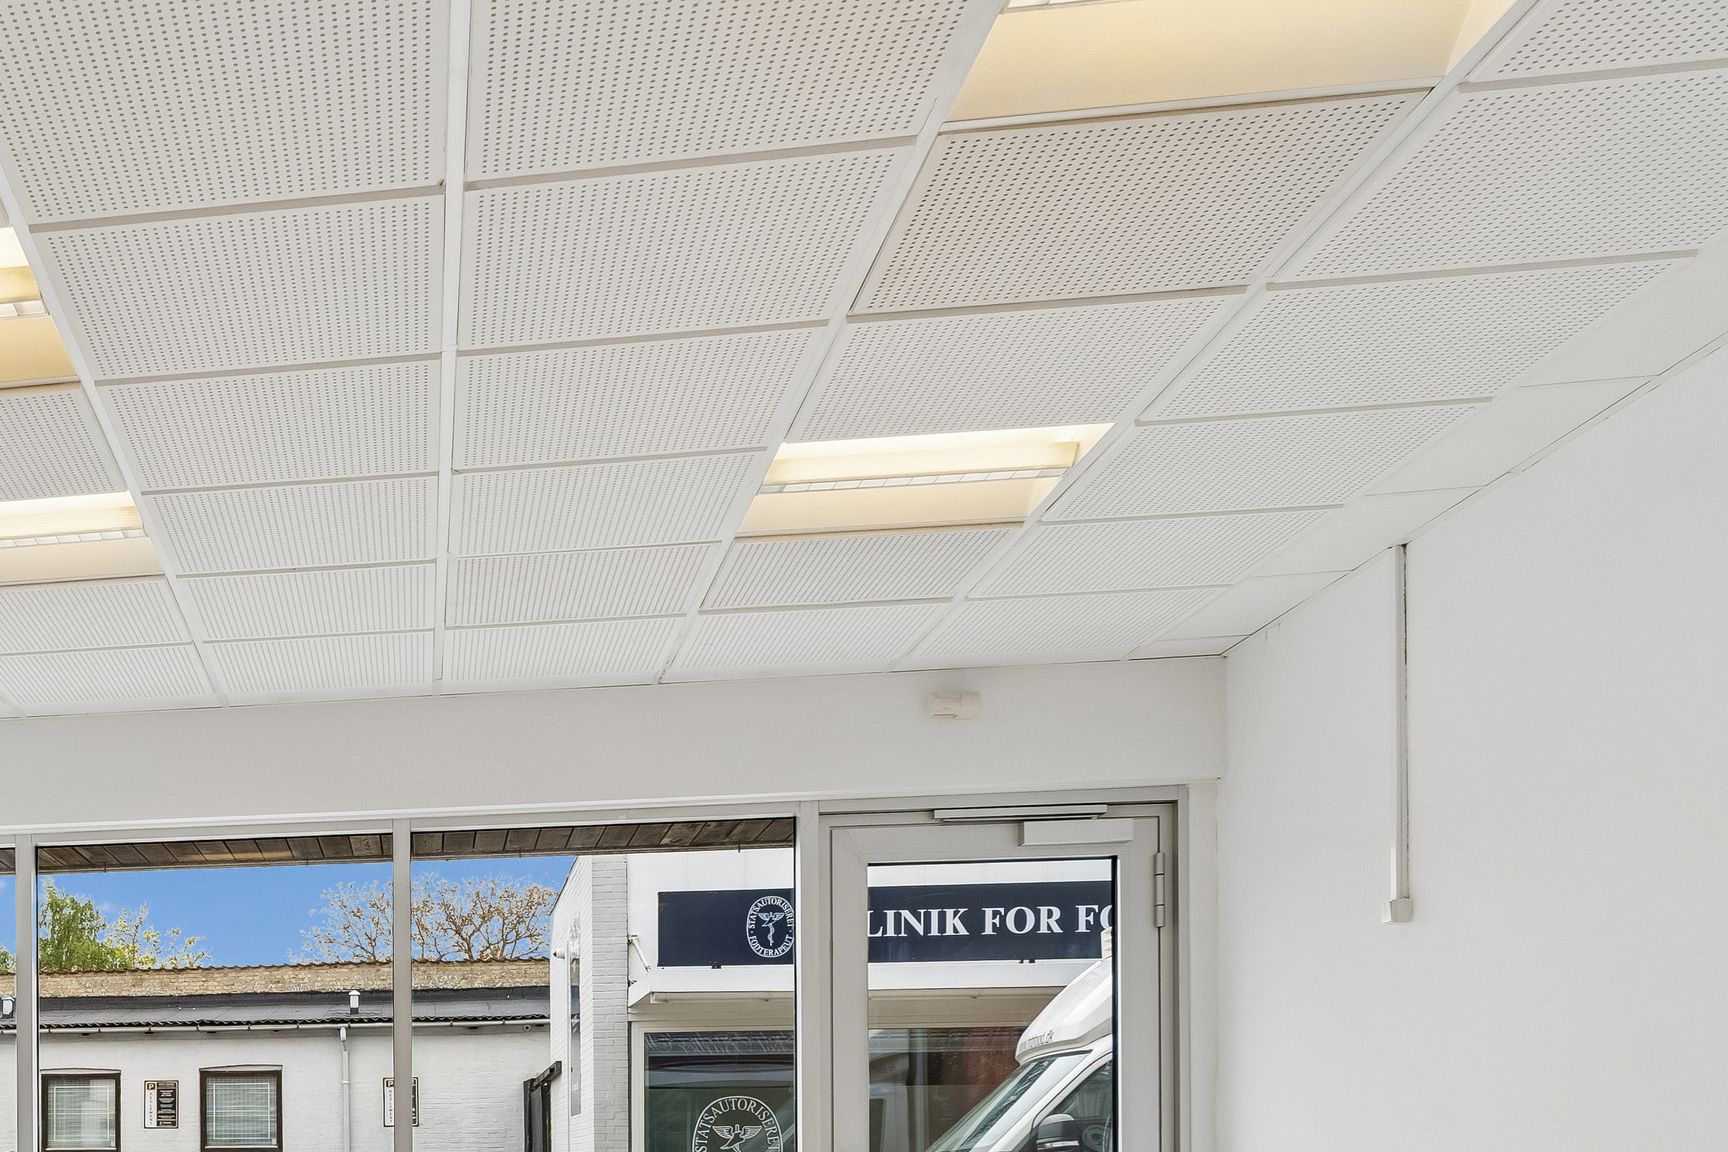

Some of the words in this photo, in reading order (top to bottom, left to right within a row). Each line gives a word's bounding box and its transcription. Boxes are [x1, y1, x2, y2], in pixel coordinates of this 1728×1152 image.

[748, 897, 793, 929] STATSAUTORISERET
[980, 905, 1064, 936] FOR
[749, 934, 793, 957] FODTERAPEUT
[694, 1098, 781, 1152] STATSAUTORISERET
